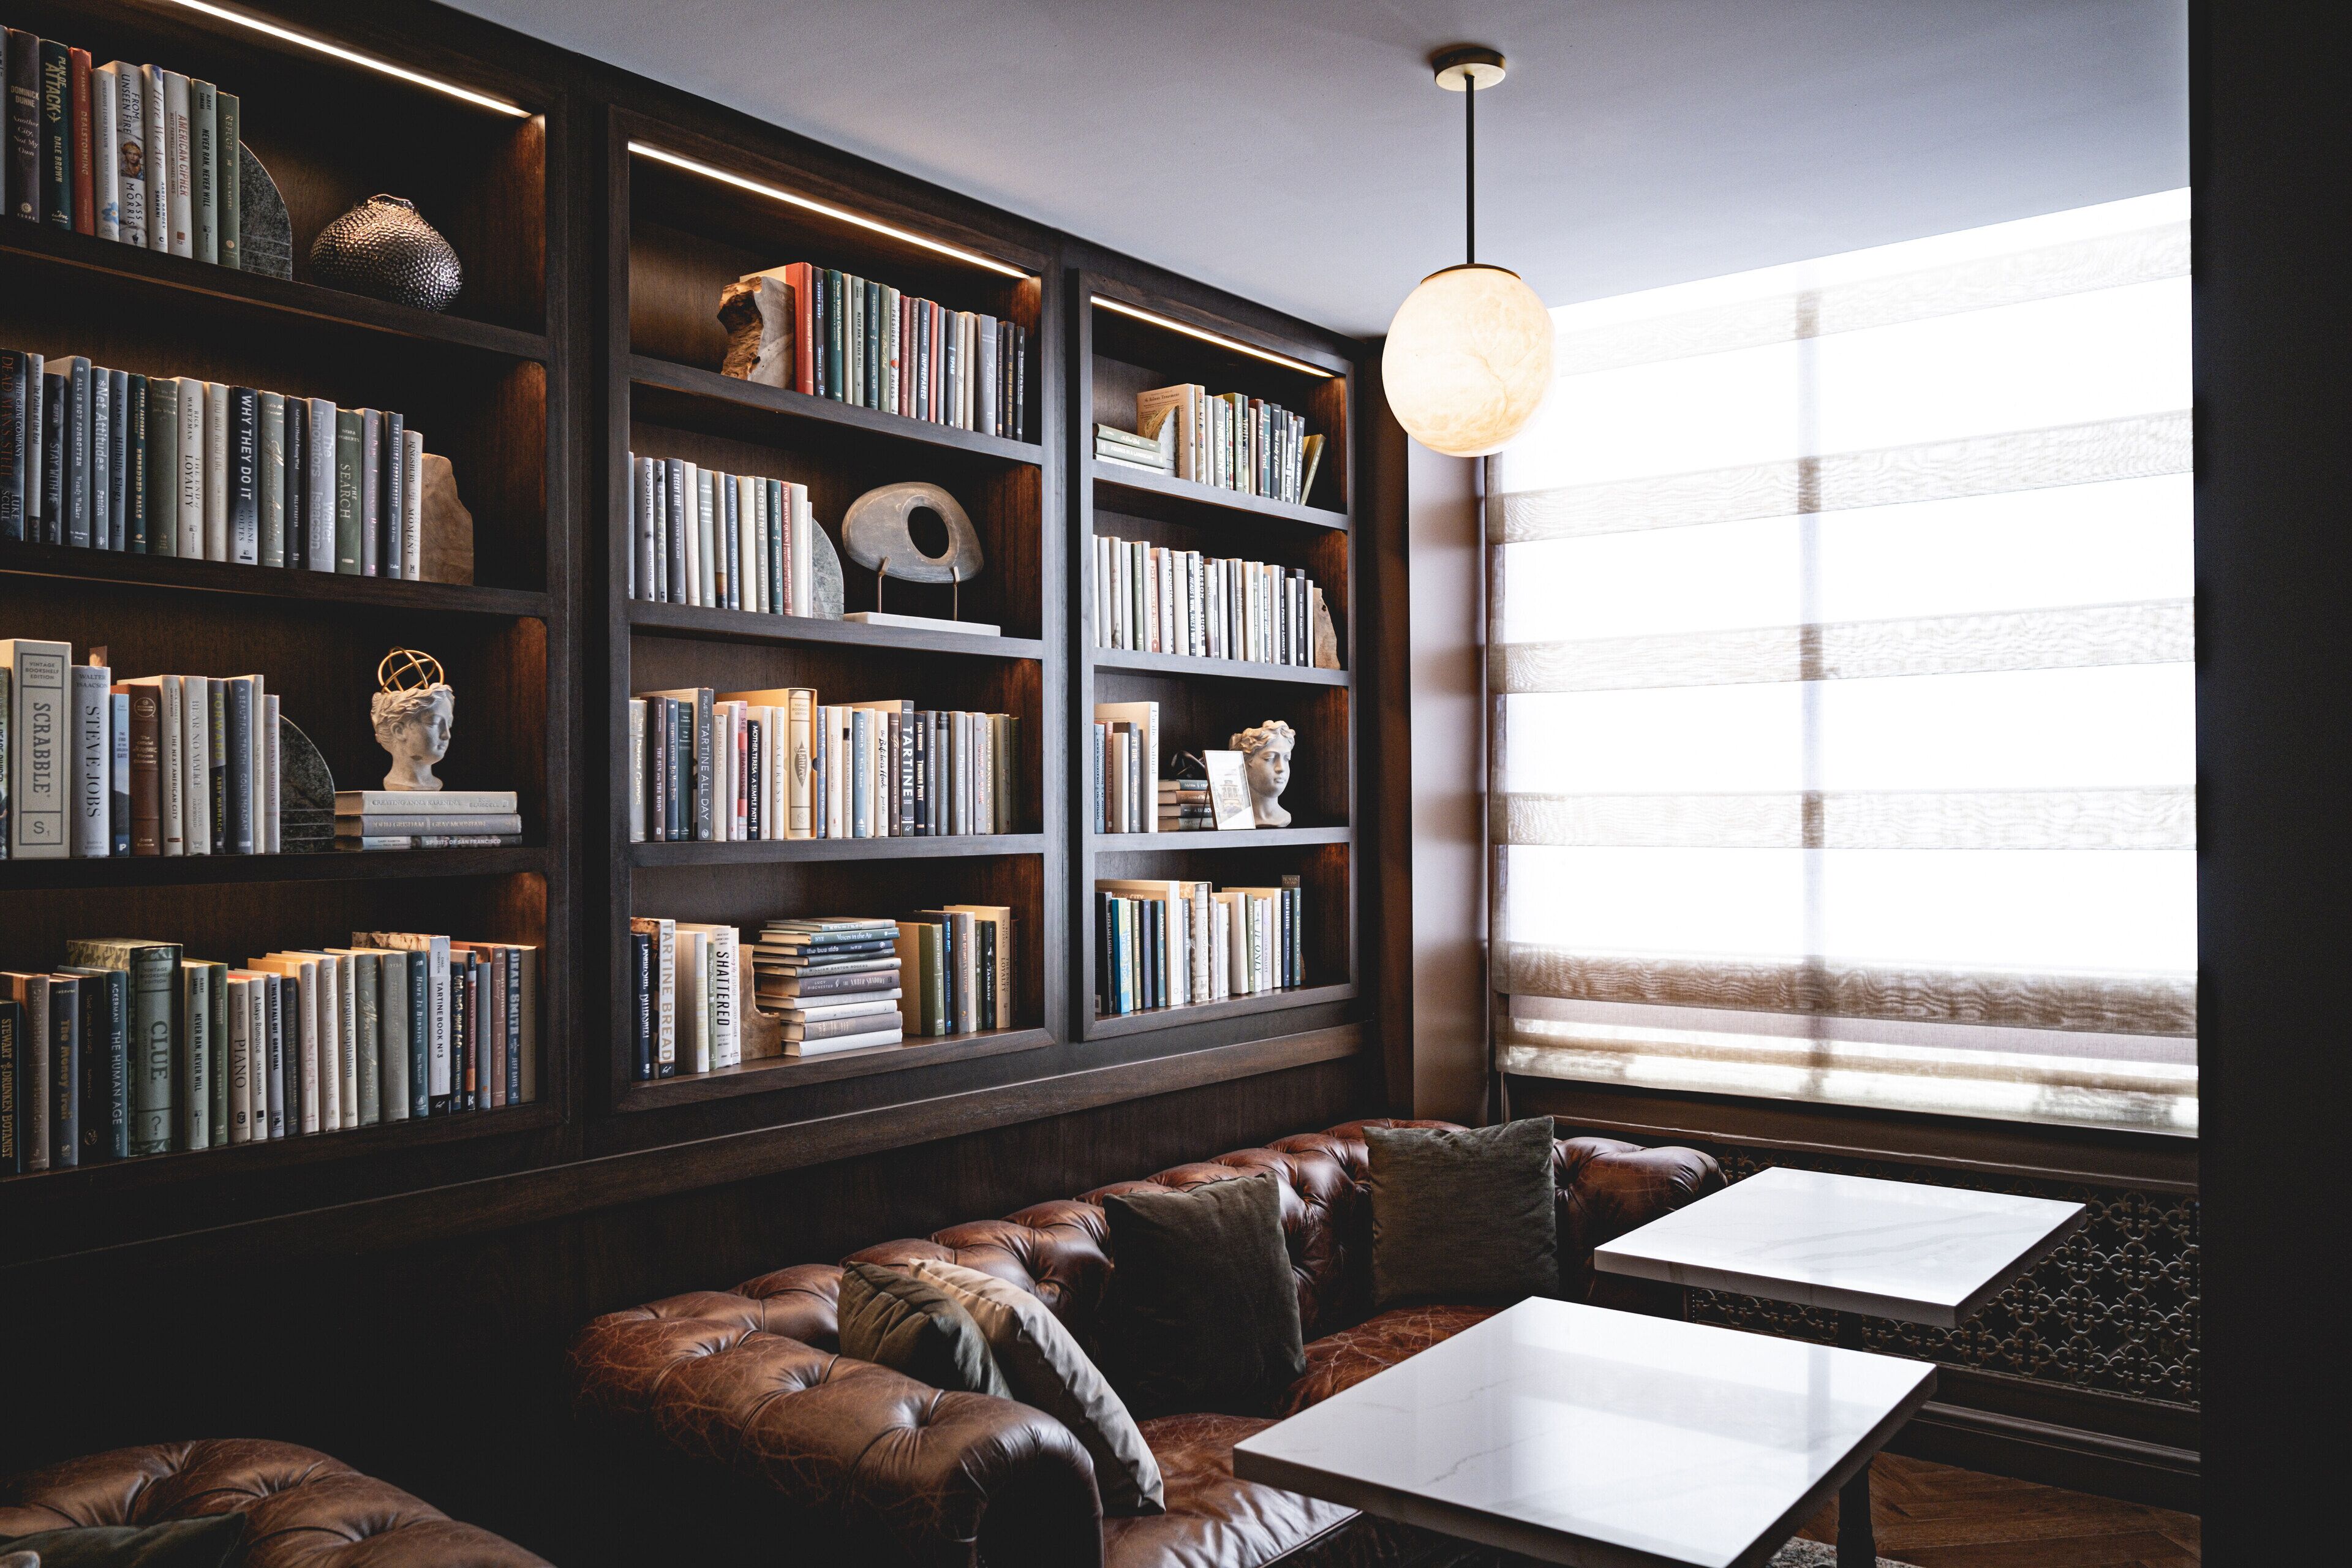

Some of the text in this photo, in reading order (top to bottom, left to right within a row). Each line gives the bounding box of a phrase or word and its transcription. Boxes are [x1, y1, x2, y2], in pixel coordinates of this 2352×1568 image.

[11, 86, 39, 100] DOMINICK
[45, 62, 61, 114] ATTACK
[122, 74, 132, 134] UNSEEN FIRE
[153, 88, 163, 168] Here We Are
[178, 115, 189, 196] AMERICAN CIPHER
[126, 183, 135, 225] MORRIS
[49, 443, 59, 503] STAY WITH ME
[113, 436, 123, 503] Hillbilly Elegy
[241, 396, 251, 499] WHY THEY DO IT
[312, 410, 323, 477] Innovators
[1, 491, 9, 521] SCULL
[312, 491, 322, 549] Isaacson
[341, 464, 350, 519] SEARCH
[405, 508, 414, 556] MOMENT
[33, 703, 50, 793] SCRABBLE
[192, 733, 200, 749] NO
[213, 692, 223, 760] FORWARD
[86, 706, 100, 818] STEVE JOBS
[795, 747, 808, 780] Yahtzee
[903, 726, 912, 796] TARTINE
[1255, 930, 1261, 941] IF
[510, 953, 519, 987] DEAN
[663, 922, 673, 1060] TARTINE BREAD
[717, 952, 729, 1025] SHATTERED
[1, 1019, 12, 1058] STEWART
[344, 993, 353, 1078] Forging Capitalism
[509, 994, 519, 1035] SMITH
[111, 1031, 122, 1125] THE HUMAN AGE
[151, 1021, 167, 1080] CLUE
[235, 1039, 246, 1088] PIANO
[1, 1071, 12, 1157] DRUNKEN BOTANIST
